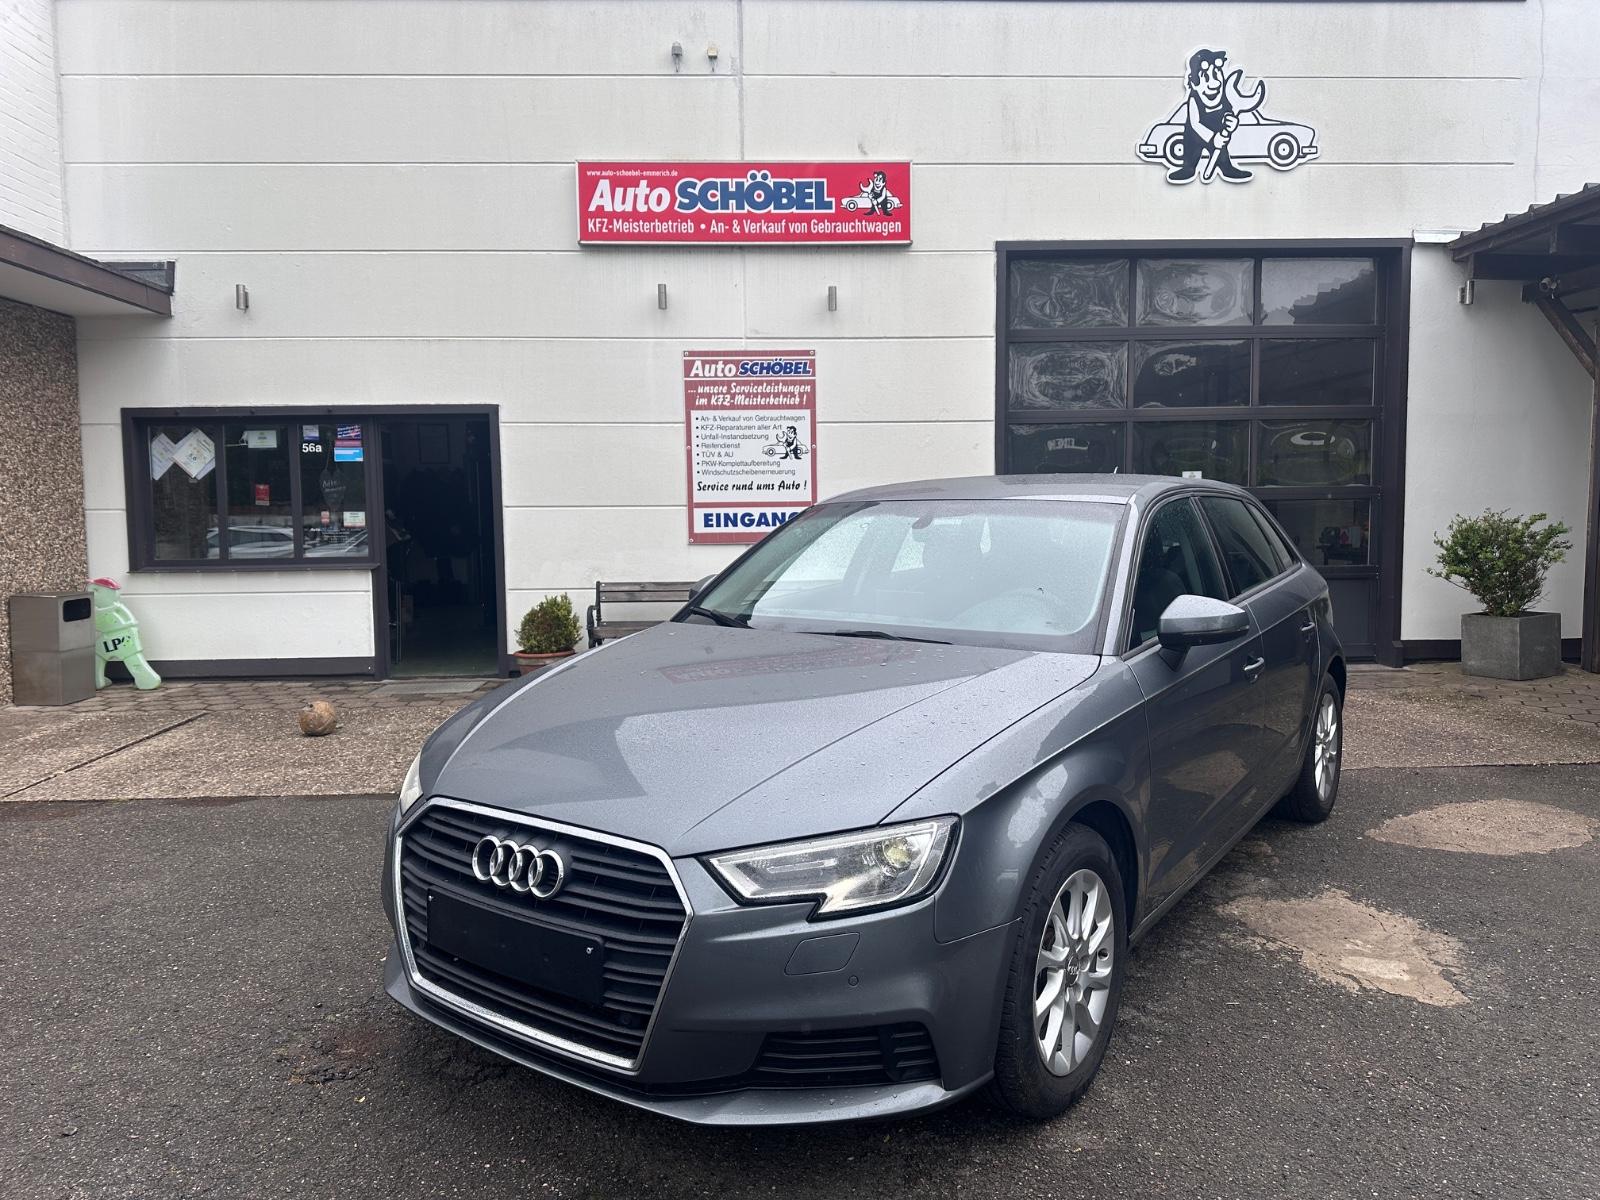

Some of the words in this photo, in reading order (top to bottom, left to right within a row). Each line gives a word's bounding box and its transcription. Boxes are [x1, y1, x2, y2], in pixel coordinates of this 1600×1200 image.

[586, 169, 678, 177] www.auto-schoebel-emmerich.de
[587, 179, 671, 212] Auto
[675, 170, 835, 213] SCHÖBEL
[587, 218, 694, 233] KFZ-Meisterbetrieb
[709, 219, 729, 233] An-
[732, 219, 741, 233] &
[743, 219, 786, 233] Verkauf
[788, 221, 808, 233] von
[810, 219, 902, 236] Gebrauchtwagen
[689, 360, 737, 377] Auto
[738, 358, 812, 376] SCHÖBEL
[730, 382, 811, 395] Serviceleistungen
[695, 395, 708, 406] im
[710, 394, 800, 406] KFZ-Meisterbetrieb
[754, 415, 806, 423] Gebrauchtwagen
[700, 424, 756, 432] KFZ-Reparaturen
[700, 433, 770, 441] Unfall-Instandsetzung
[302, 443, 322, 453] 56a
[701, 450, 716, 458] TÜV
[696, 481, 729, 491] Service
[731, 480, 753, 491] rund
[756, 483, 775, 491] ums
[777, 480, 801, 491] Auto
